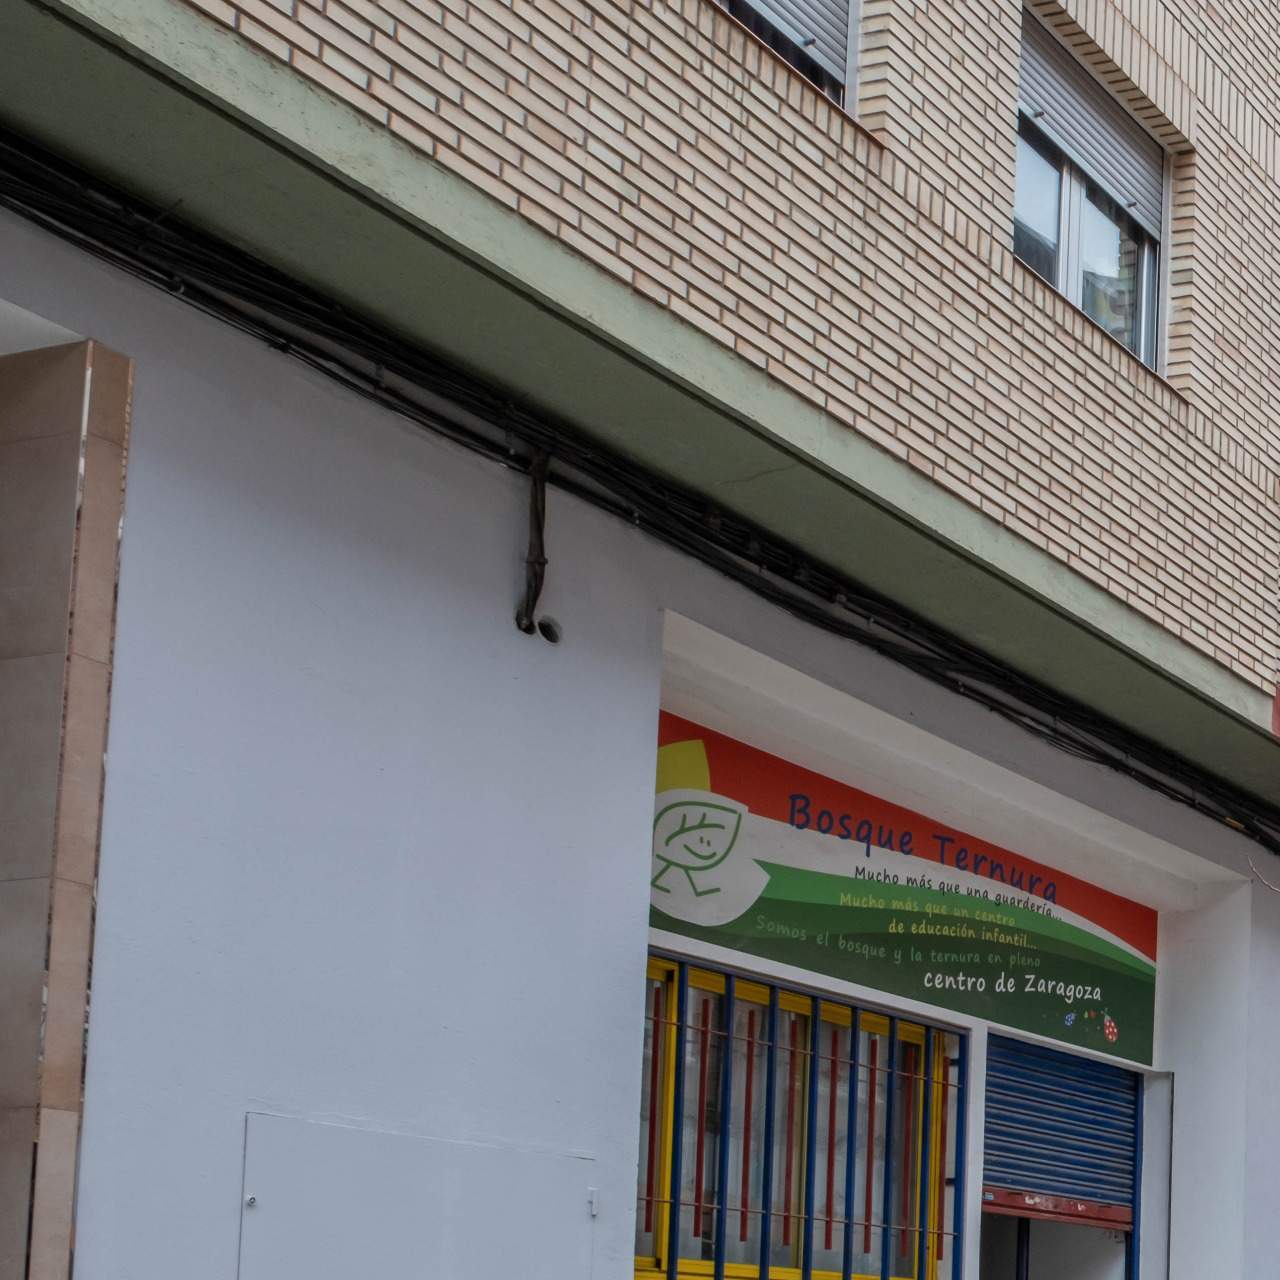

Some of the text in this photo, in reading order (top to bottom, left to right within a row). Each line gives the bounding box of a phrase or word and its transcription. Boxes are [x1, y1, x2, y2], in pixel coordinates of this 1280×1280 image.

[788, 793, 1057, 904] Bosque Ternura
[854, 865, 899, 885] Mucho
[906, 873, 933, 890] más
[939, 881, 960, 896] que
[966, 887, 988, 900] una
[840, 892, 1016, 927] Mucho más que un centro
[755, 914, 1041, 969] Somos el bosque y la ternura en pleno
[888, 919, 905, 934] de
[911, 920, 976, 939] educación
[924, 972, 1102, 1004] centro de Zaragoza
